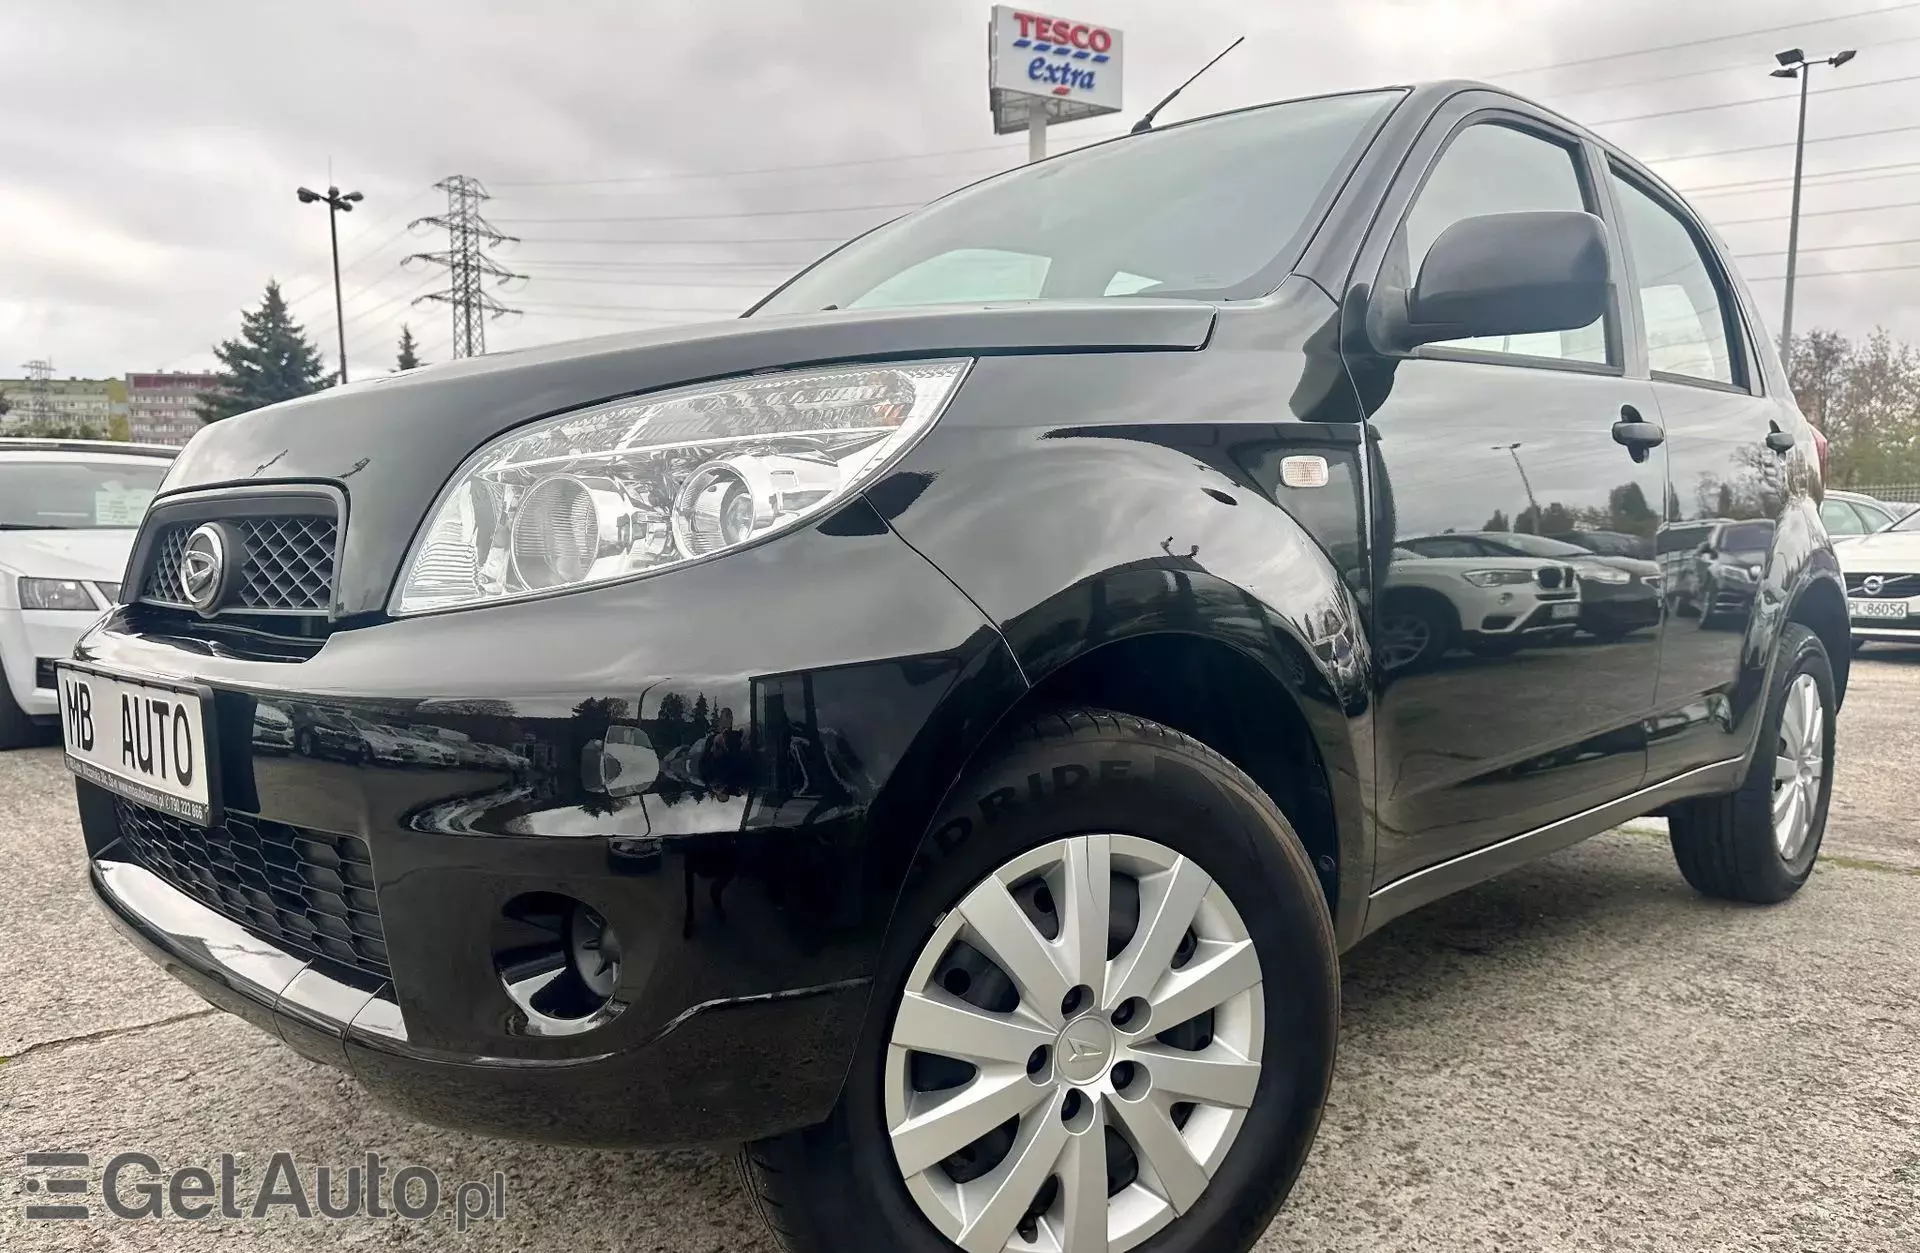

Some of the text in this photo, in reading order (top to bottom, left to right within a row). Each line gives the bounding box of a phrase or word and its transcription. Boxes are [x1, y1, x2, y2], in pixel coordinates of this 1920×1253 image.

[1013, 12, 1112, 53] TESCO
[1028, 56, 1096, 90] extra
[1867, 603, 1904, 617] 86056
[65, 679, 193, 787] MB AUTO
[181, 800, 192, 817] 222
